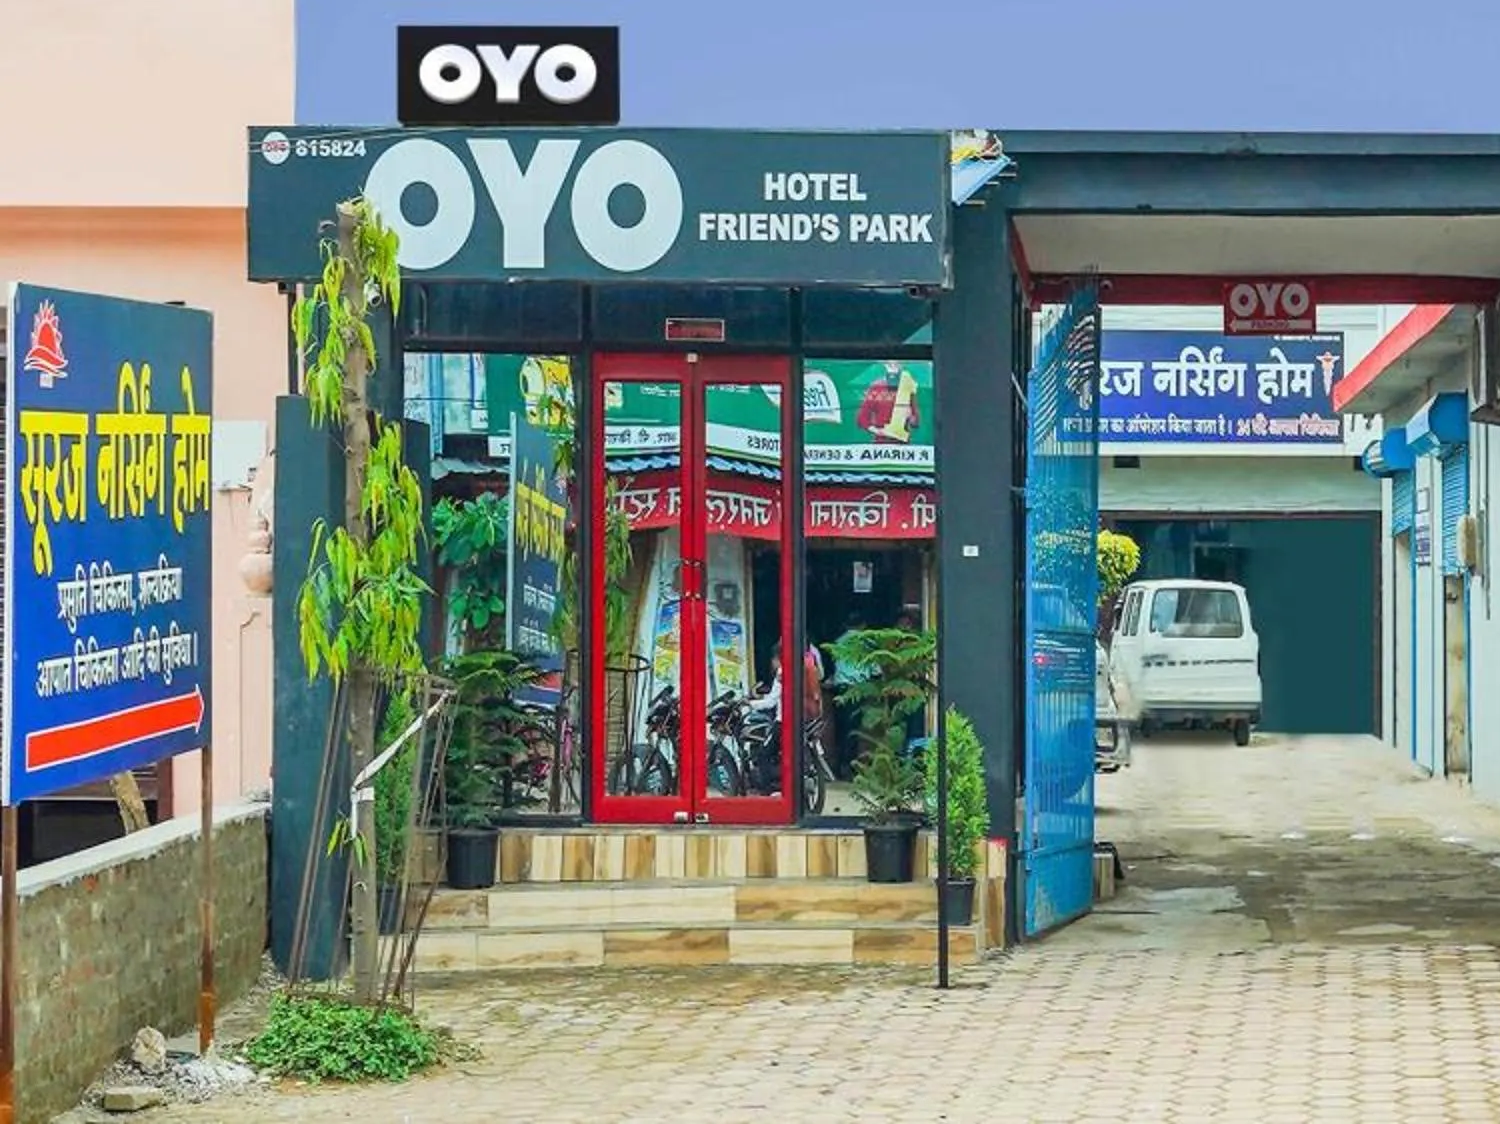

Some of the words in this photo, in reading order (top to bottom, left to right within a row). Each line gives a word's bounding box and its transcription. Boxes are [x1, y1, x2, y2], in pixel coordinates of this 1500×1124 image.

[419, 43, 597, 105] OYO
[295, 139, 367, 157] 815824
[364, 138, 684, 272] OYO
[763, 172, 868, 202] HOTEL
[699, 212, 841, 242] FRIEND'S
[849, 213, 934, 243] PARK
[1230, 283, 1310, 317] OYO
[1098, 361, 1145, 398] रज
[1152, 345, 1248, 398] नर्सिंग
[1255, 346, 1315, 405] होम
[20, 410, 89, 577] सूरज
[95, 361, 167, 519] नर्सिंग
[171, 365, 211, 534] होम
